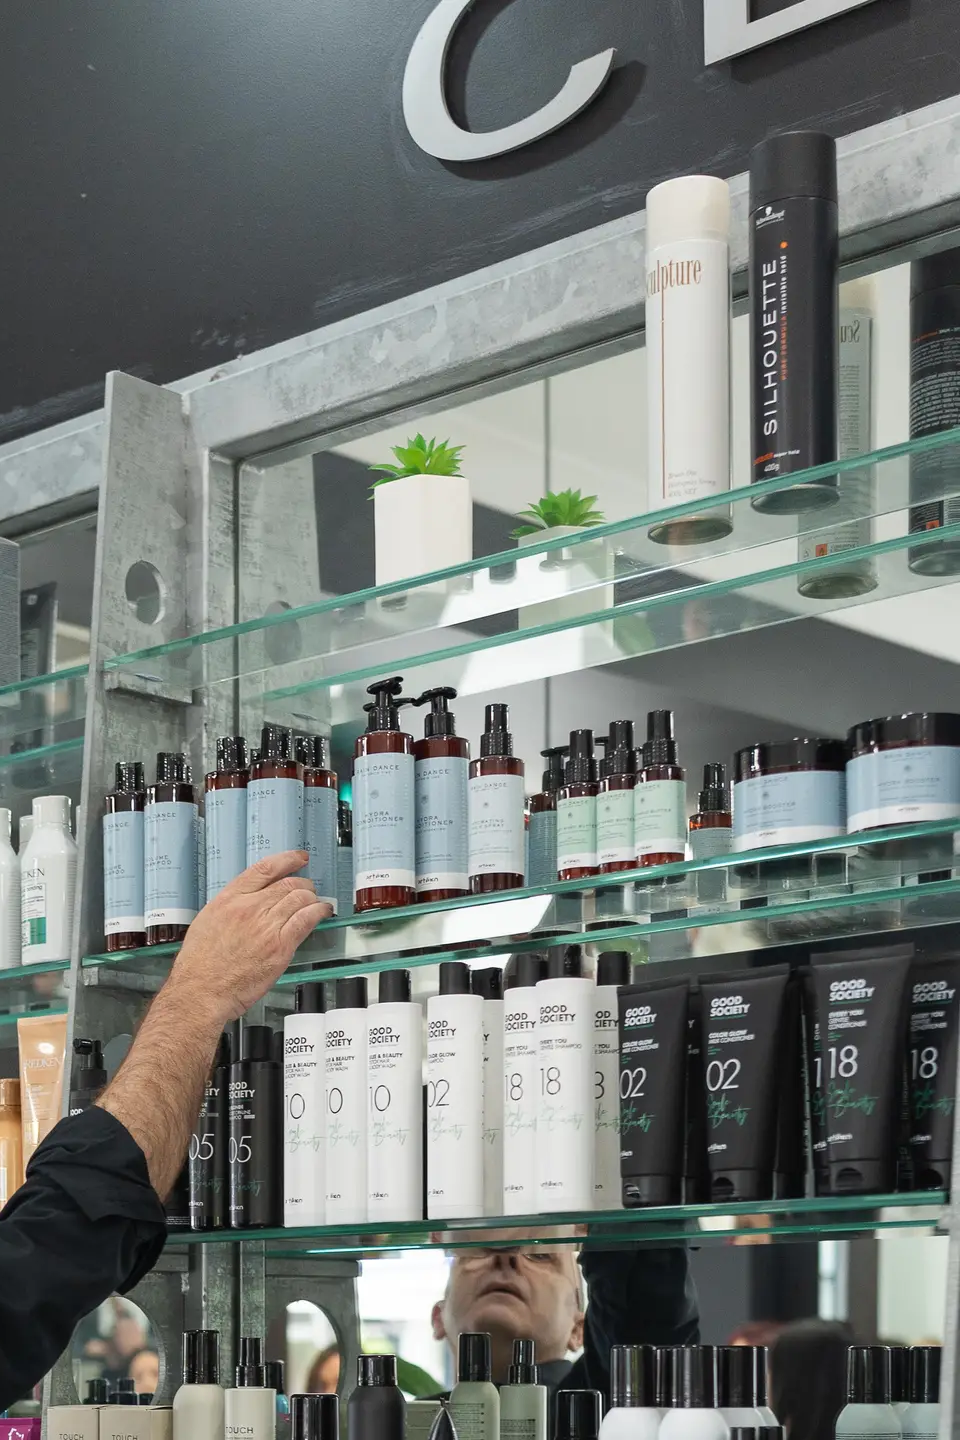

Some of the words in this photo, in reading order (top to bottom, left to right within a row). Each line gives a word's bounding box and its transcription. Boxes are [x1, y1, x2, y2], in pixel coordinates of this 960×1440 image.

[762, 259, 779, 436] SILHOUETTE
[423, 769, 449, 777] DANCE
[830, 979, 867, 992] GOOD
[913, 981, 948, 993] GOOD
[711, 995, 743, 1007] GOOD
[829, 987, 876, 1002] SOCIETY
[912, 989, 956, 1003] SOCIETY
[540, 1004, 567, 1014] GOOD
[625, 1006, 651, 1018] GOOD
[710, 1003, 751, 1017] SOCIETY
[540, 1013, 576, 1024] SOCIETY
[624, 1013, 658, 1027] SOCIETY
[369, 1026, 393, 1036] GOOD
[369, 1034, 401, 1045] SOCIETY
[828, 1044, 859, 1079] 18
[911, 1047, 938, 1080] 18
[706, 1058, 741, 1092] 02
[814, 1057, 822, 1088] 1
[540, 1066, 561, 1096] 18
[620, 1067, 647, 1100] 02
[69, 1108, 84, 1116] OOD
[228, 1135, 252, 1164] 05
[59, 1433, 84, 1440] TOUCH
[225, 1426, 254, 1434] TOUCH
